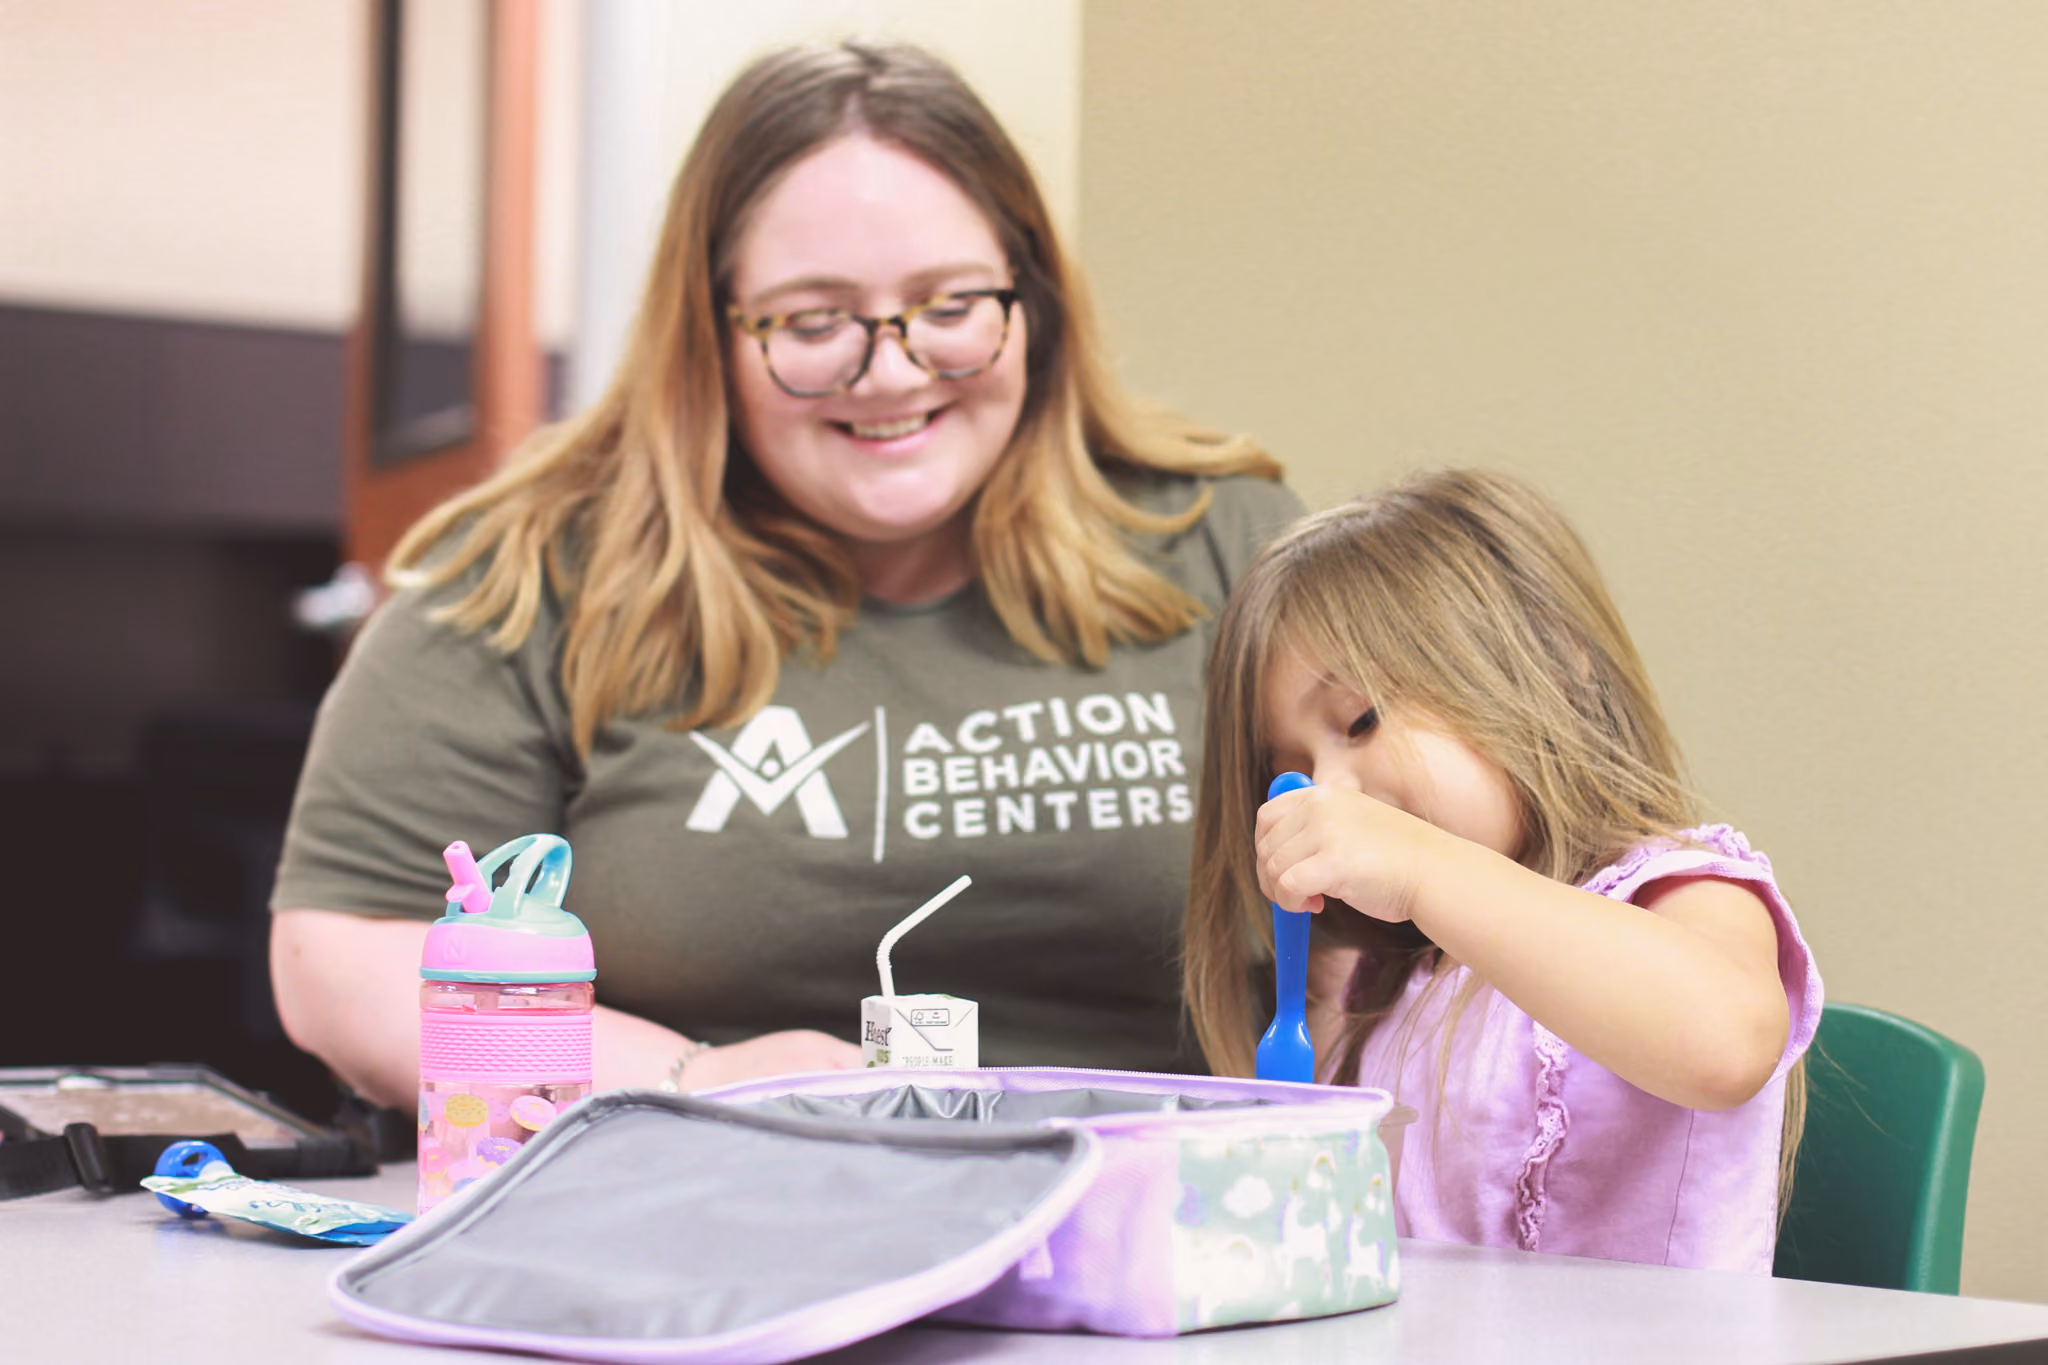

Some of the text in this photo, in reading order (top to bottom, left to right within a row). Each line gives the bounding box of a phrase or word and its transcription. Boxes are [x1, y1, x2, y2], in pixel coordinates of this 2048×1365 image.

[903, 692, 1176, 754] ACTION
[902, 739, 1186, 796] BEHAVIOR
[903, 784, 1194, 840] CENTERS
